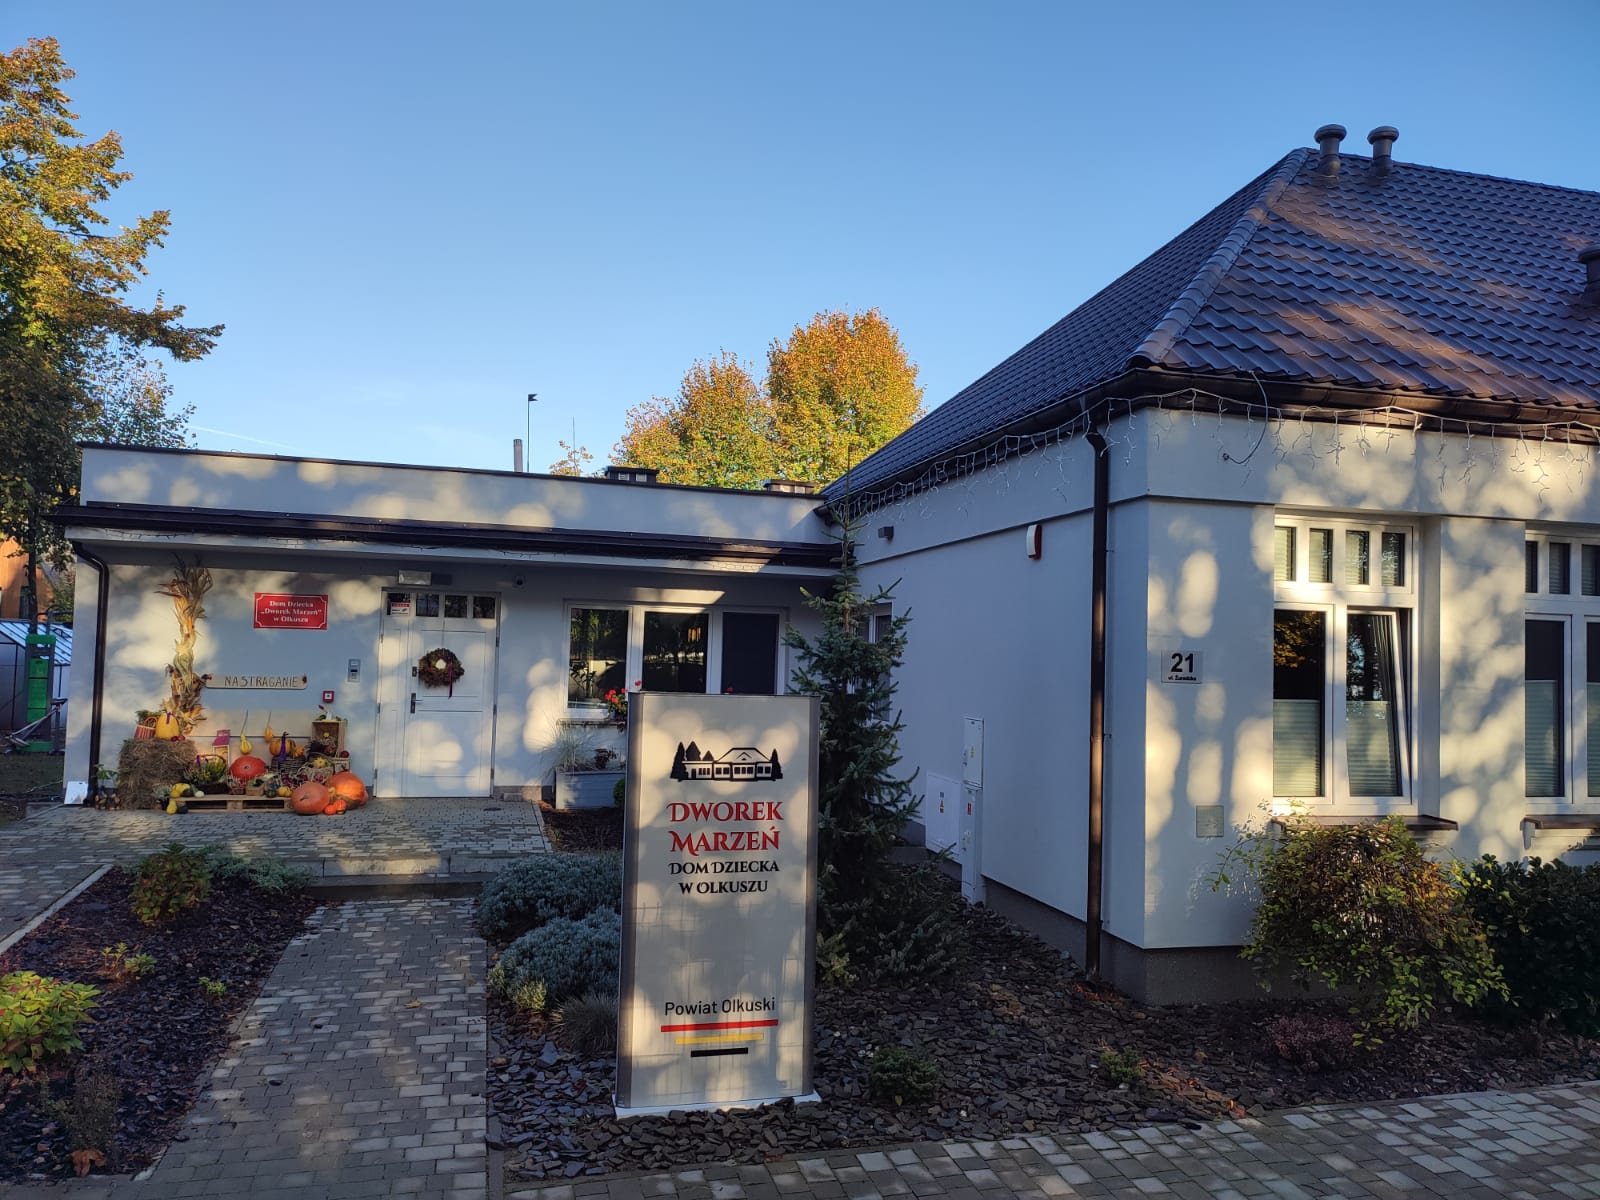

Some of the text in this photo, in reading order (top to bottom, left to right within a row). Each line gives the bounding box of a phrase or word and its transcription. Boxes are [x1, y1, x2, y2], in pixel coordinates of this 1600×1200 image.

[1171, 652, 1194, 673] 21
[666, 801, 784, 823] DWOREK
[668, 826, 781, 857] MARZEŃ
[668, 860, 780, 875] DOM DZIECKA
[696, 880, 768, 894] OLKUSZU
[665, 997, 776, 1016] Powiat Olkuski
